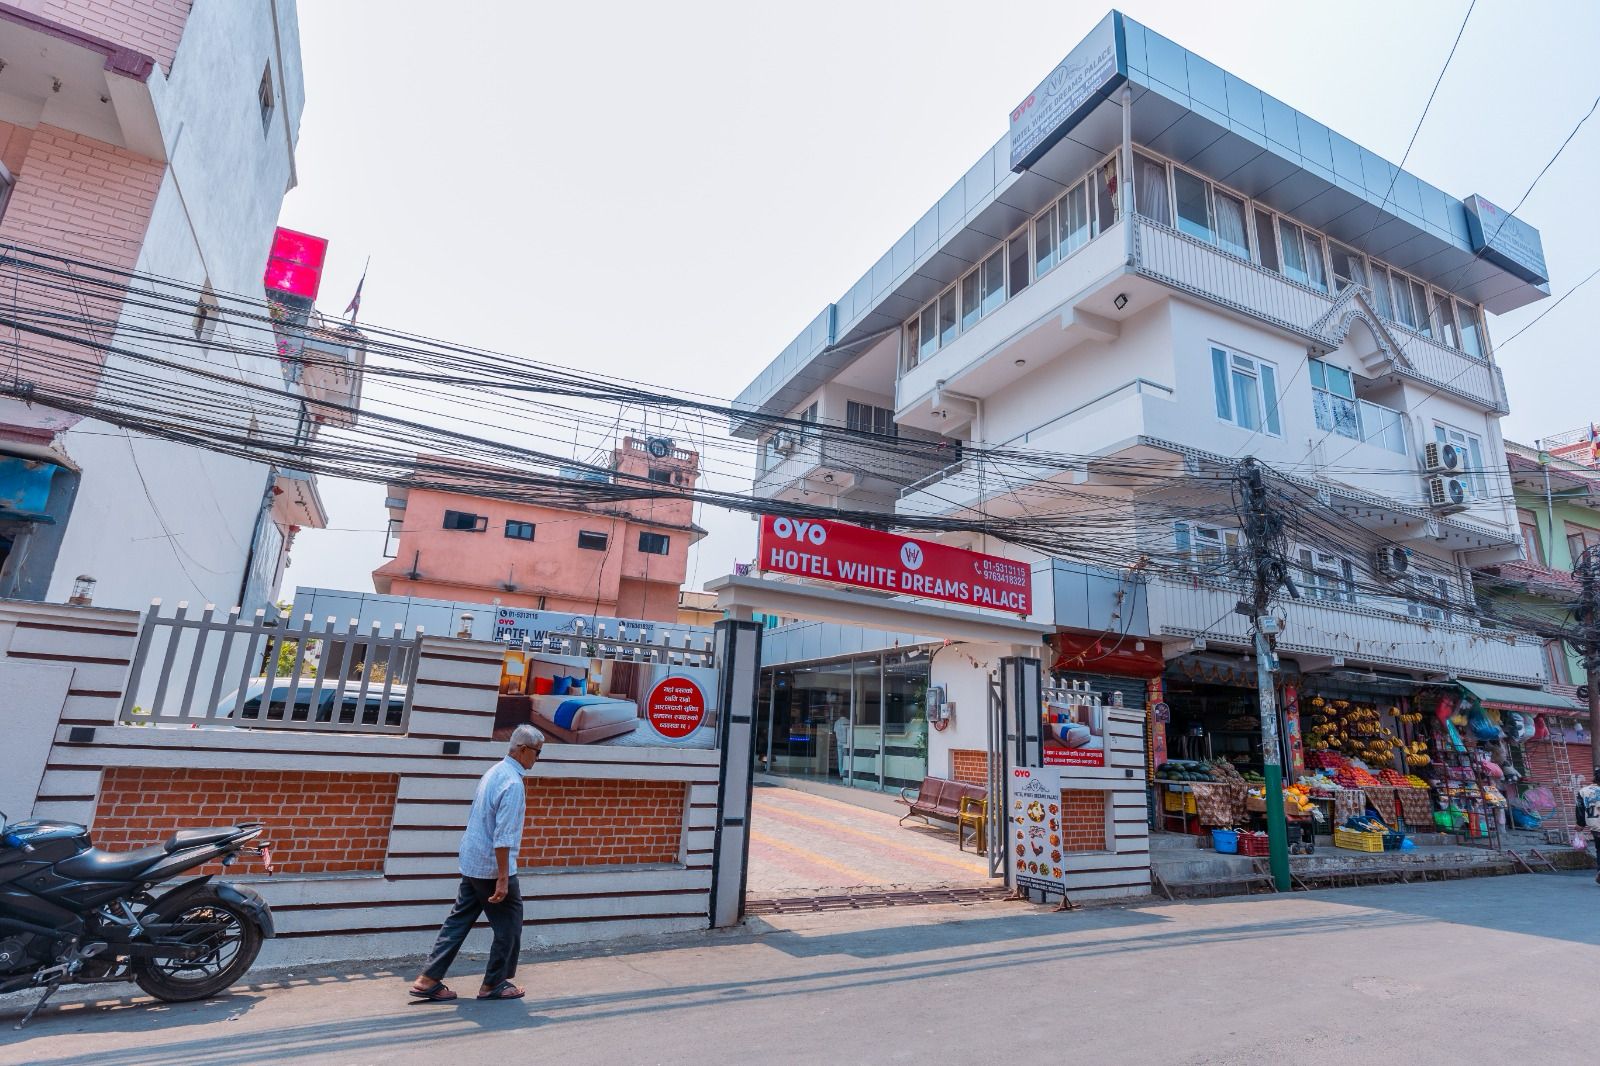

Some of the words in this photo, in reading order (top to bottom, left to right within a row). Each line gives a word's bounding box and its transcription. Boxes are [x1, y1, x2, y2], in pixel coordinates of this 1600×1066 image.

[1012, 126, 1031, 146] HOTEL
[1032, 104, 1053, 125] WHITE
[1054, 75, 1083, 105] DREAMS
[1084, 46, 1111, 74] PALACE
[1012, 96, 1035, 122] OYO
[773, 517, 827, 546] OYO
[771, 547, 833, 576] HOTEL
[837, 559, 896, 588] WHITE
[901, 572, 969, 600] DREAMS
[973, 585, 1027, 610] PALACE
[983, 570, 1026, 587] 9763418322
[498, 618, 515, 626] OYO
[1014, 769, 1030, 778] OYO
